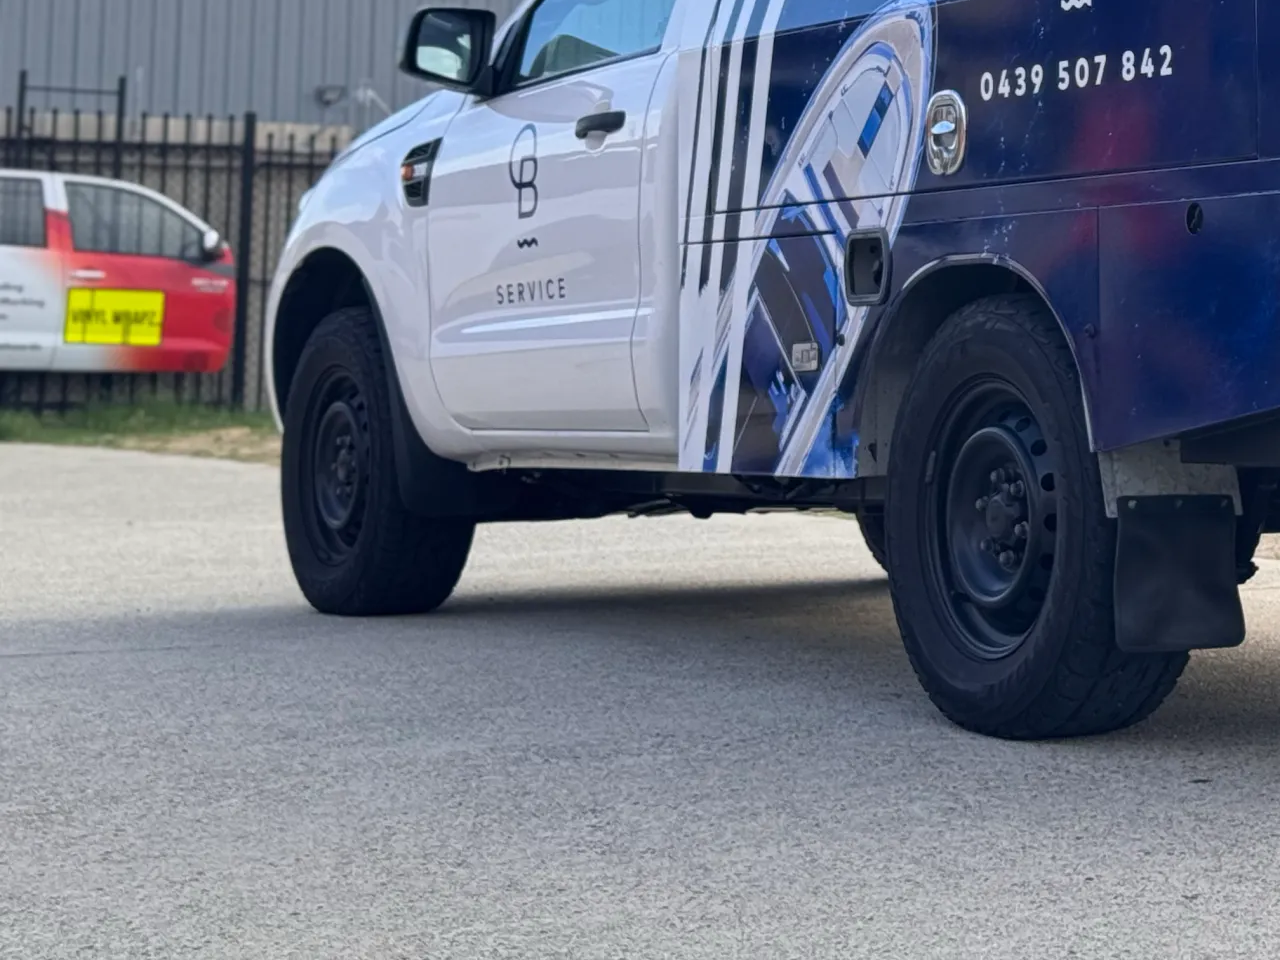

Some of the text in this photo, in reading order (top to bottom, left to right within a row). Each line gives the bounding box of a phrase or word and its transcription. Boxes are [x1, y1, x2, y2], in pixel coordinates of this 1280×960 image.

[979, 44, 1173, 102] 0439 507 842
[496, 277, 566, 305] SERVICE
